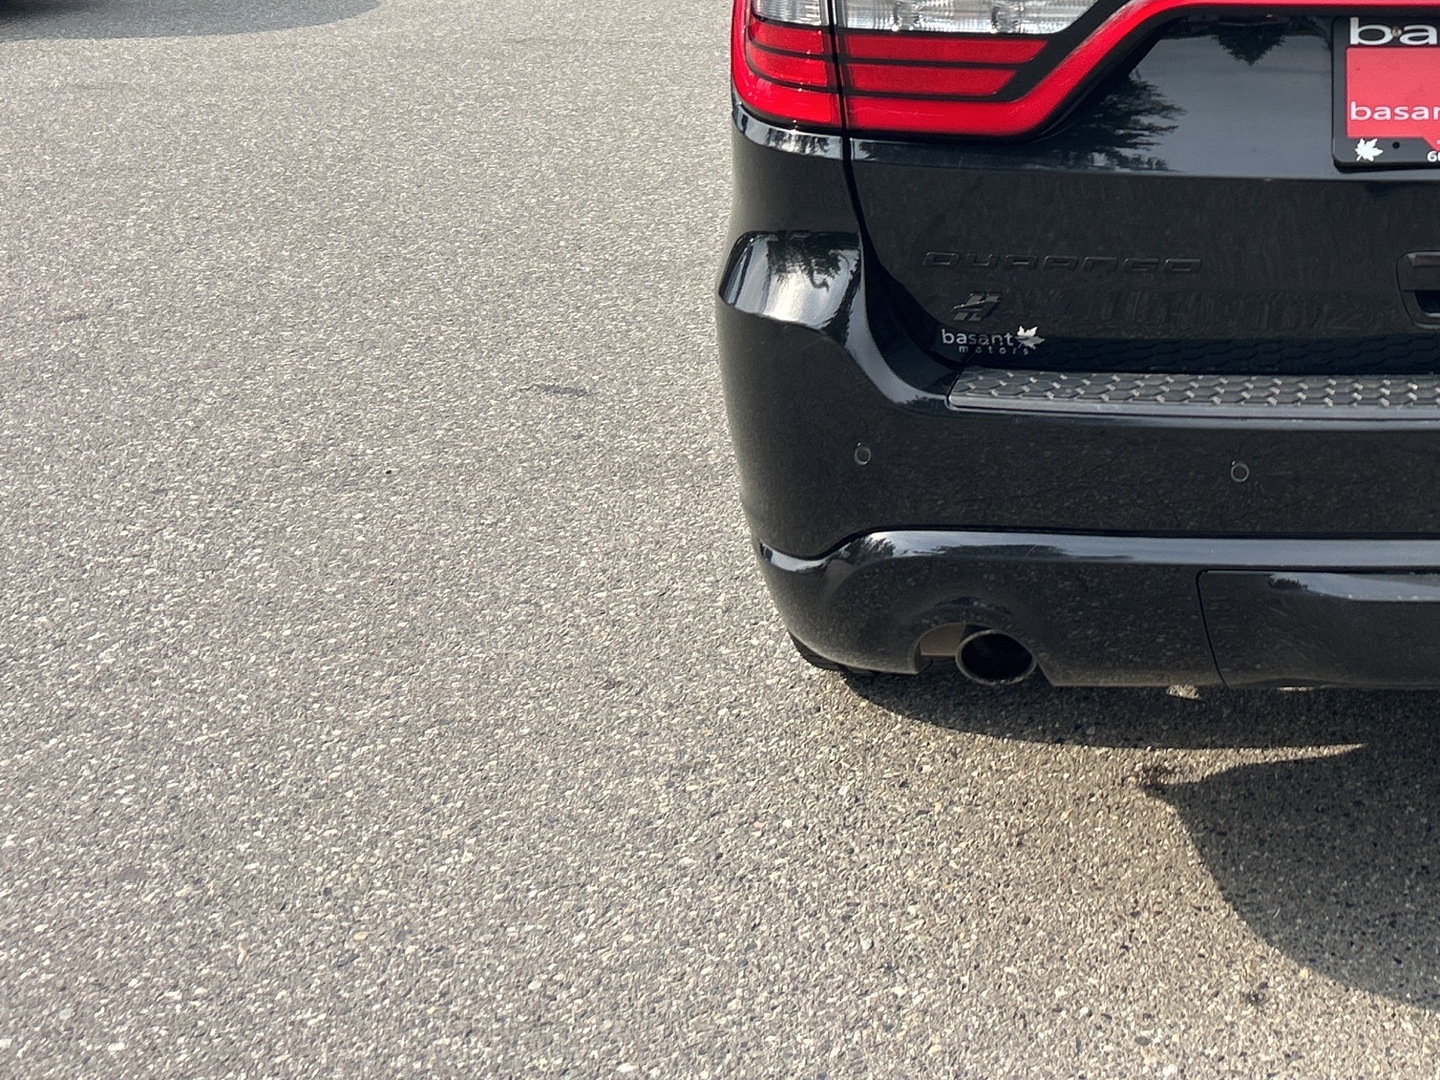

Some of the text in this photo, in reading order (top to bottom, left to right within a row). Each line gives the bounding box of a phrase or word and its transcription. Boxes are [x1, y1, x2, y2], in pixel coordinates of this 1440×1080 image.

[922, 251, 1201, 272] DURANGO
[941, 328, 1015, 346] basant
[959, 345, 1030, 356] motors
